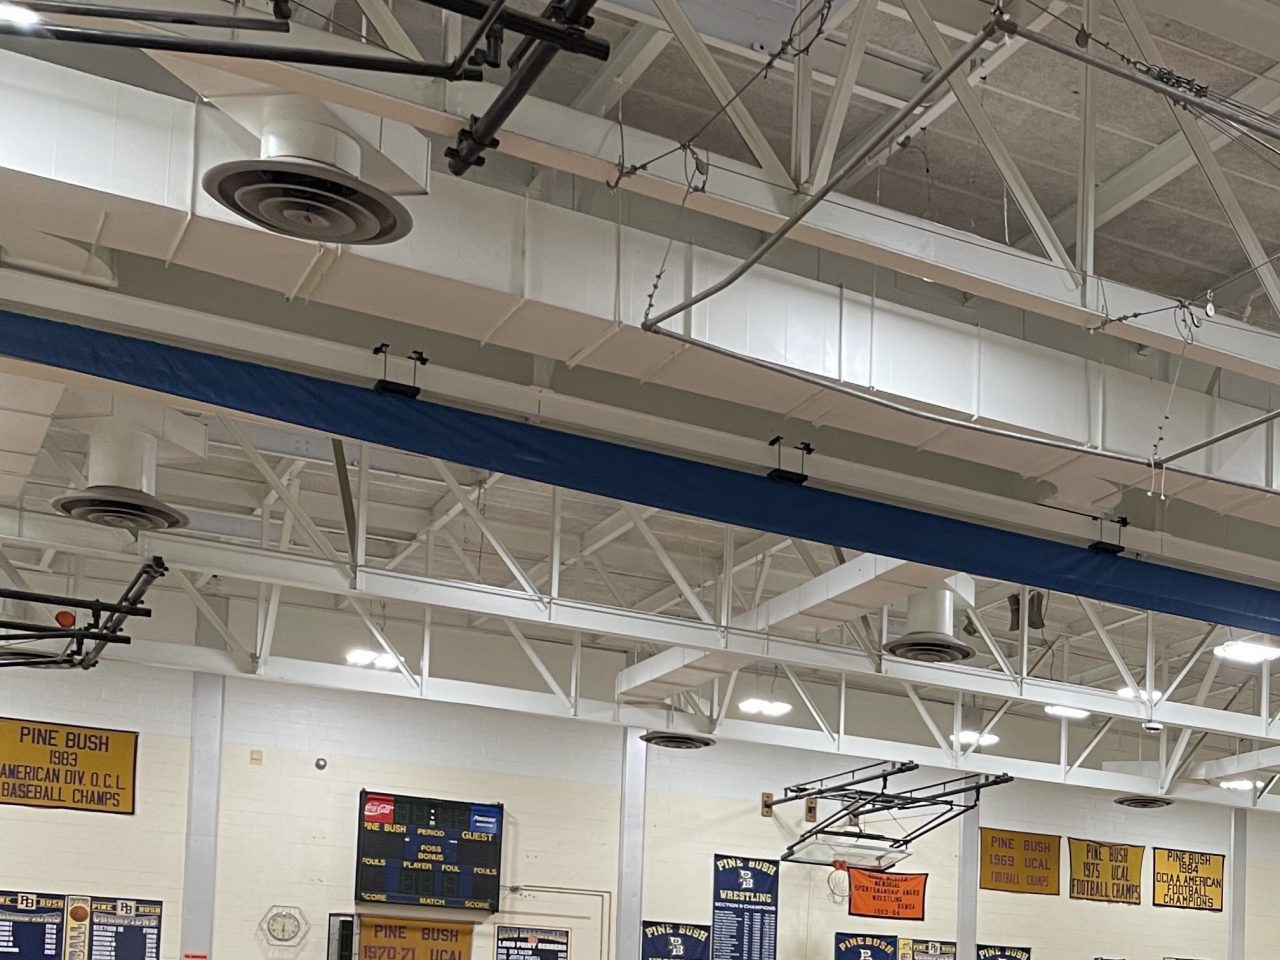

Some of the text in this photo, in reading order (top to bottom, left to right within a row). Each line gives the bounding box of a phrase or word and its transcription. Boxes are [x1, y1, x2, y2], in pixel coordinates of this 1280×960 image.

[20, 726, 110, 752] PINE BUSH
[50, 750, 78, 768] 1983
[0, 763, 60, 784] AMERICAN
[64, 770, 86, 786] DIV.
[1, 782, 120, 808] BASEBALL CHAMPS
[384, 824, 406, 834] BUSH
[417, 828, 444, 837] PERIOD
[462, 830, 494, 842] GUEST
[991, 836, 1050, 853] PINE BUSH
[1086, 844, 1128, 863] PINE BUSH
[1167, 851, 1211, 865] PINE BUSH
[403, 861, 432, 870] PLAYER
[442, 864, 460, 872] FOUL
[716, 858, 777, 876] PINE BUSH
[989, 853, 1052, 871] 1969 UCAL
[1179, 863, 1199, 874] 1984
[991, 871, 1049, 887] FOOTBALL CHAMPS
[1083, 862, 1130, 882] 1975 UCAL
[1071, 878, 1140, 900] FOOTBALL CHAMPS
[1183, 875, 1222, 888] AMERICAN
[720, 890, 772, 903] WRESTLING
[1167, 884, 1209, 897] FOOTBALL
[1163, 894, 1214, 908] CHAMPIONS
[374, 924, 459, 943] PINE BUSH
[644, 924, 708, 942] PINE BUSH
[364, 945, 416, 960] 1970-71
[838, 936, 894, 954] PINE BUSH
[978, 948, 1001, 960] PINE
